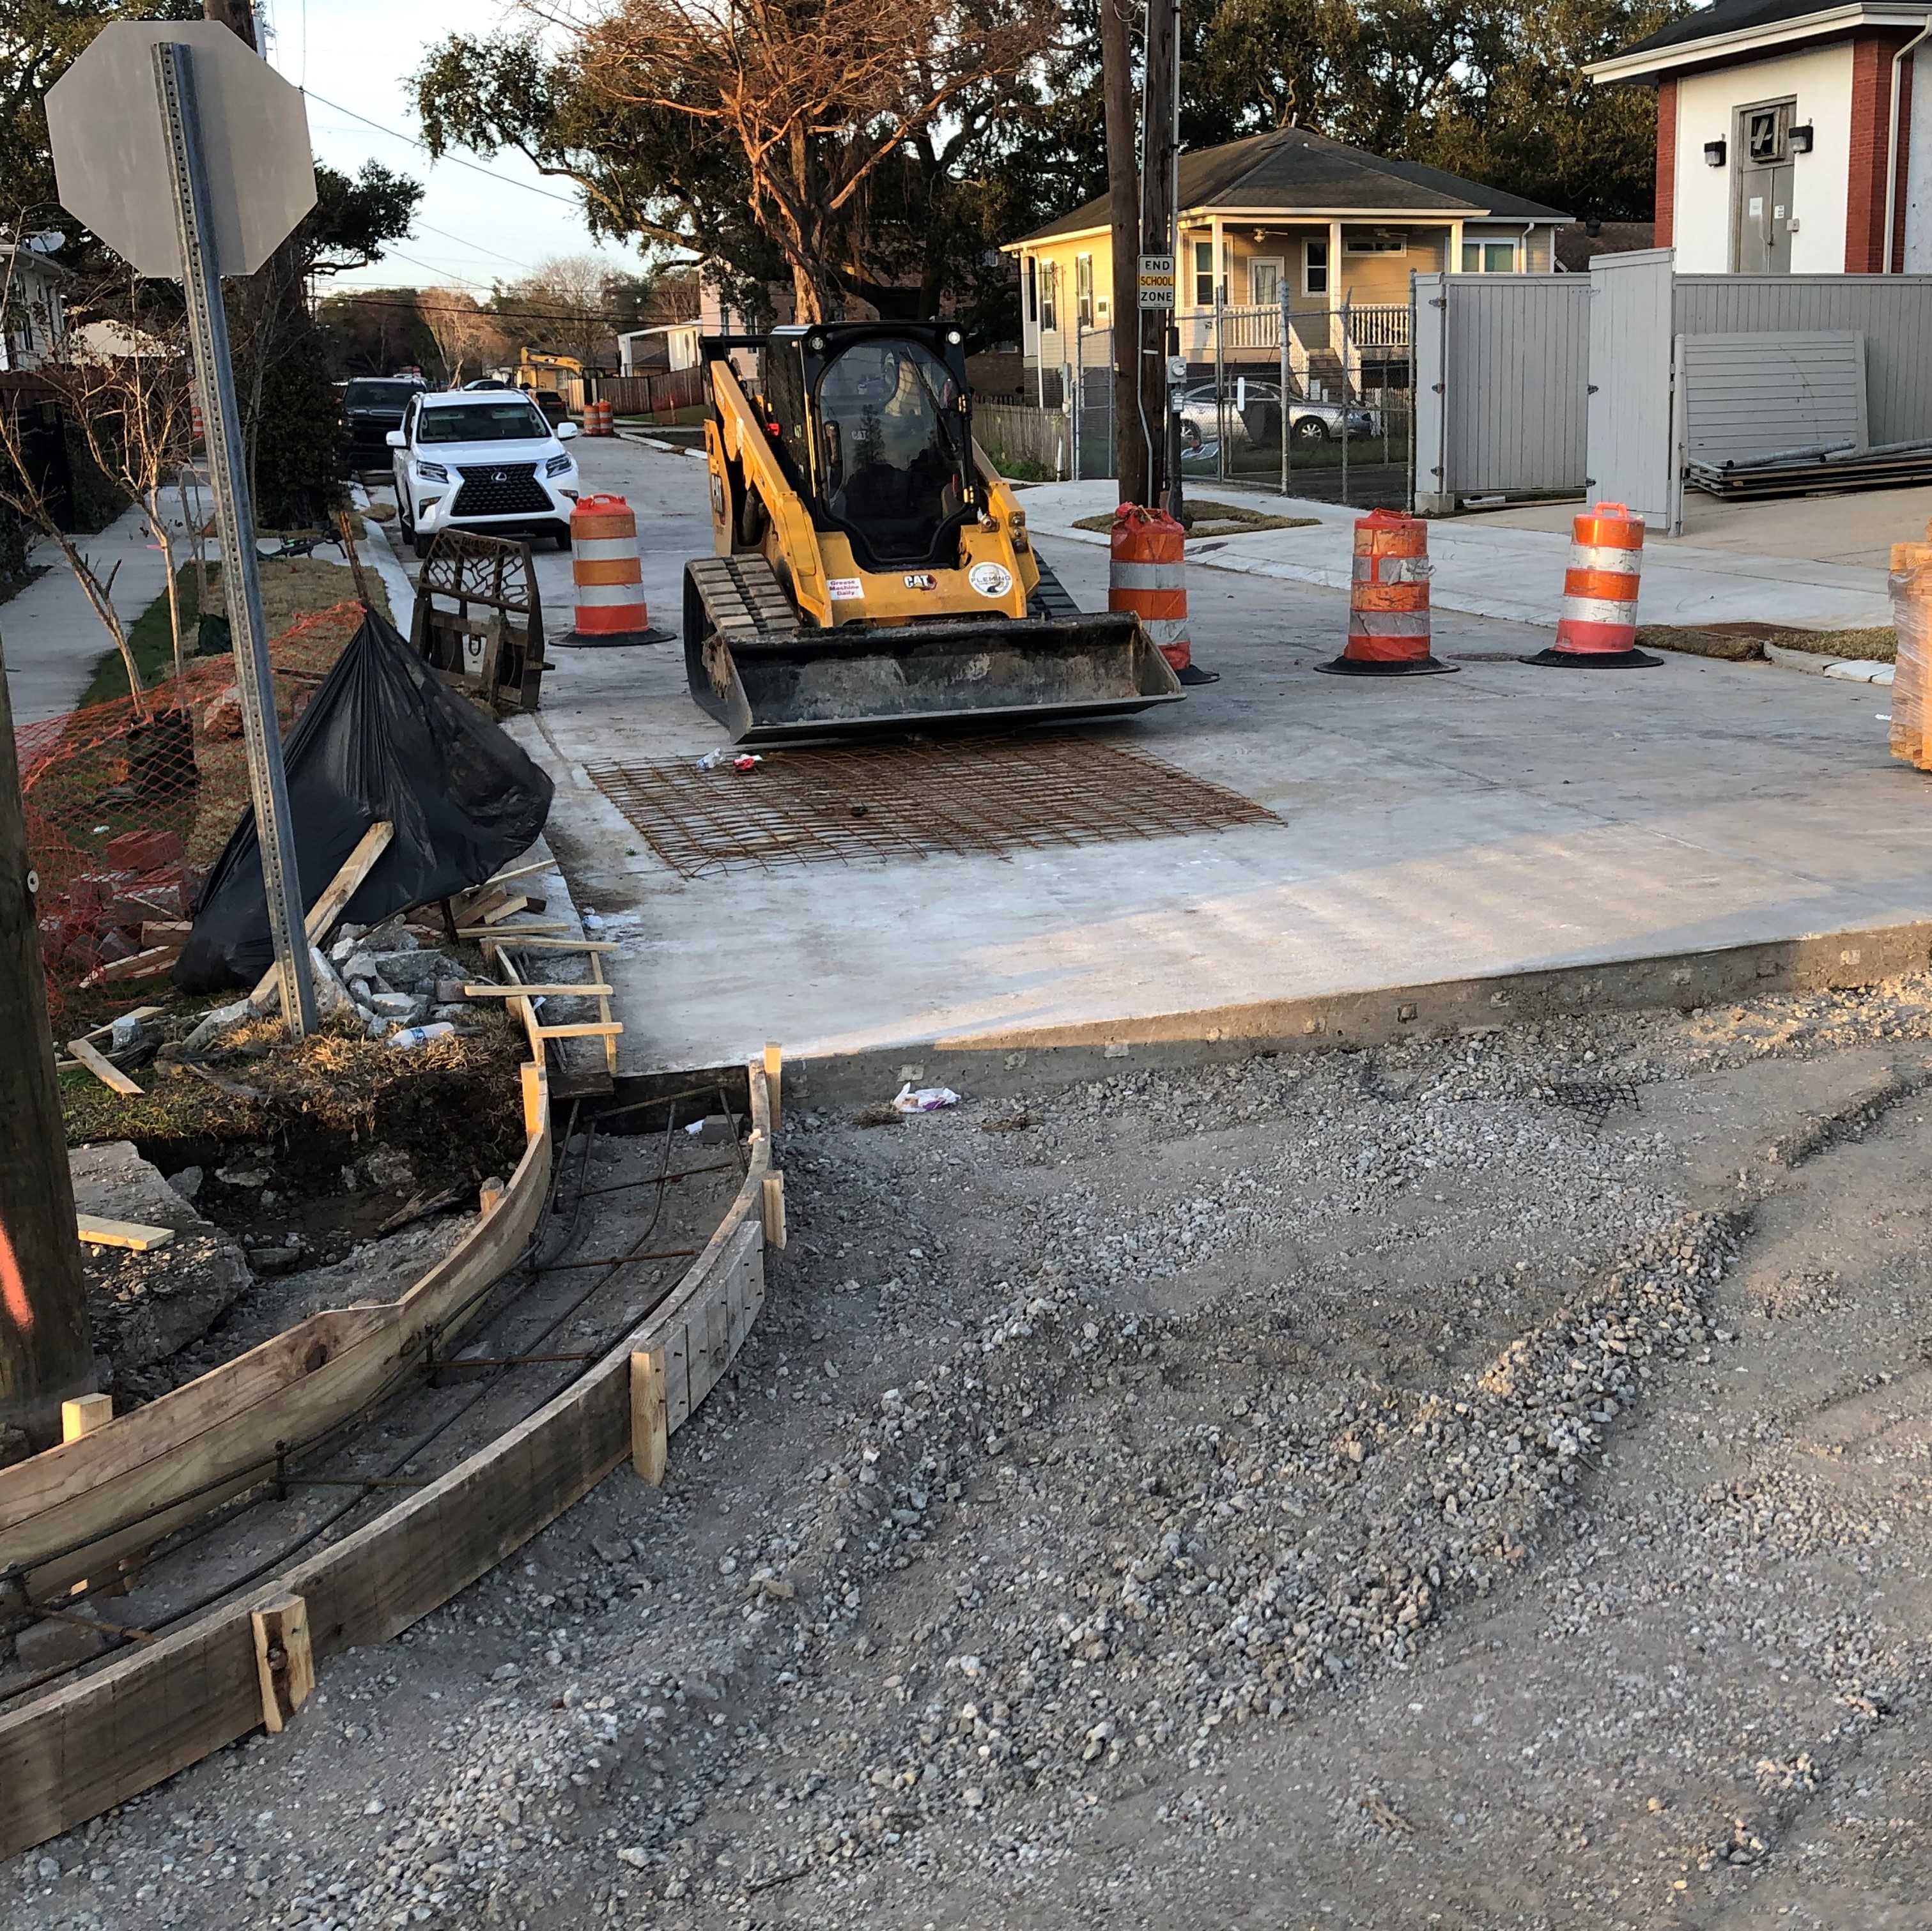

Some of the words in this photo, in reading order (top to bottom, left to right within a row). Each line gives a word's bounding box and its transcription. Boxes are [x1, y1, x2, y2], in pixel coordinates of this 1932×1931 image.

[1145, 261, 1170, 270] END
[1140, 276, 1173, 286] SCHOOL
[1141, 291, 1173, 302] ZONE
[851, 430, 866, 440] CAT
[904, 575, 929, 588] CAT
